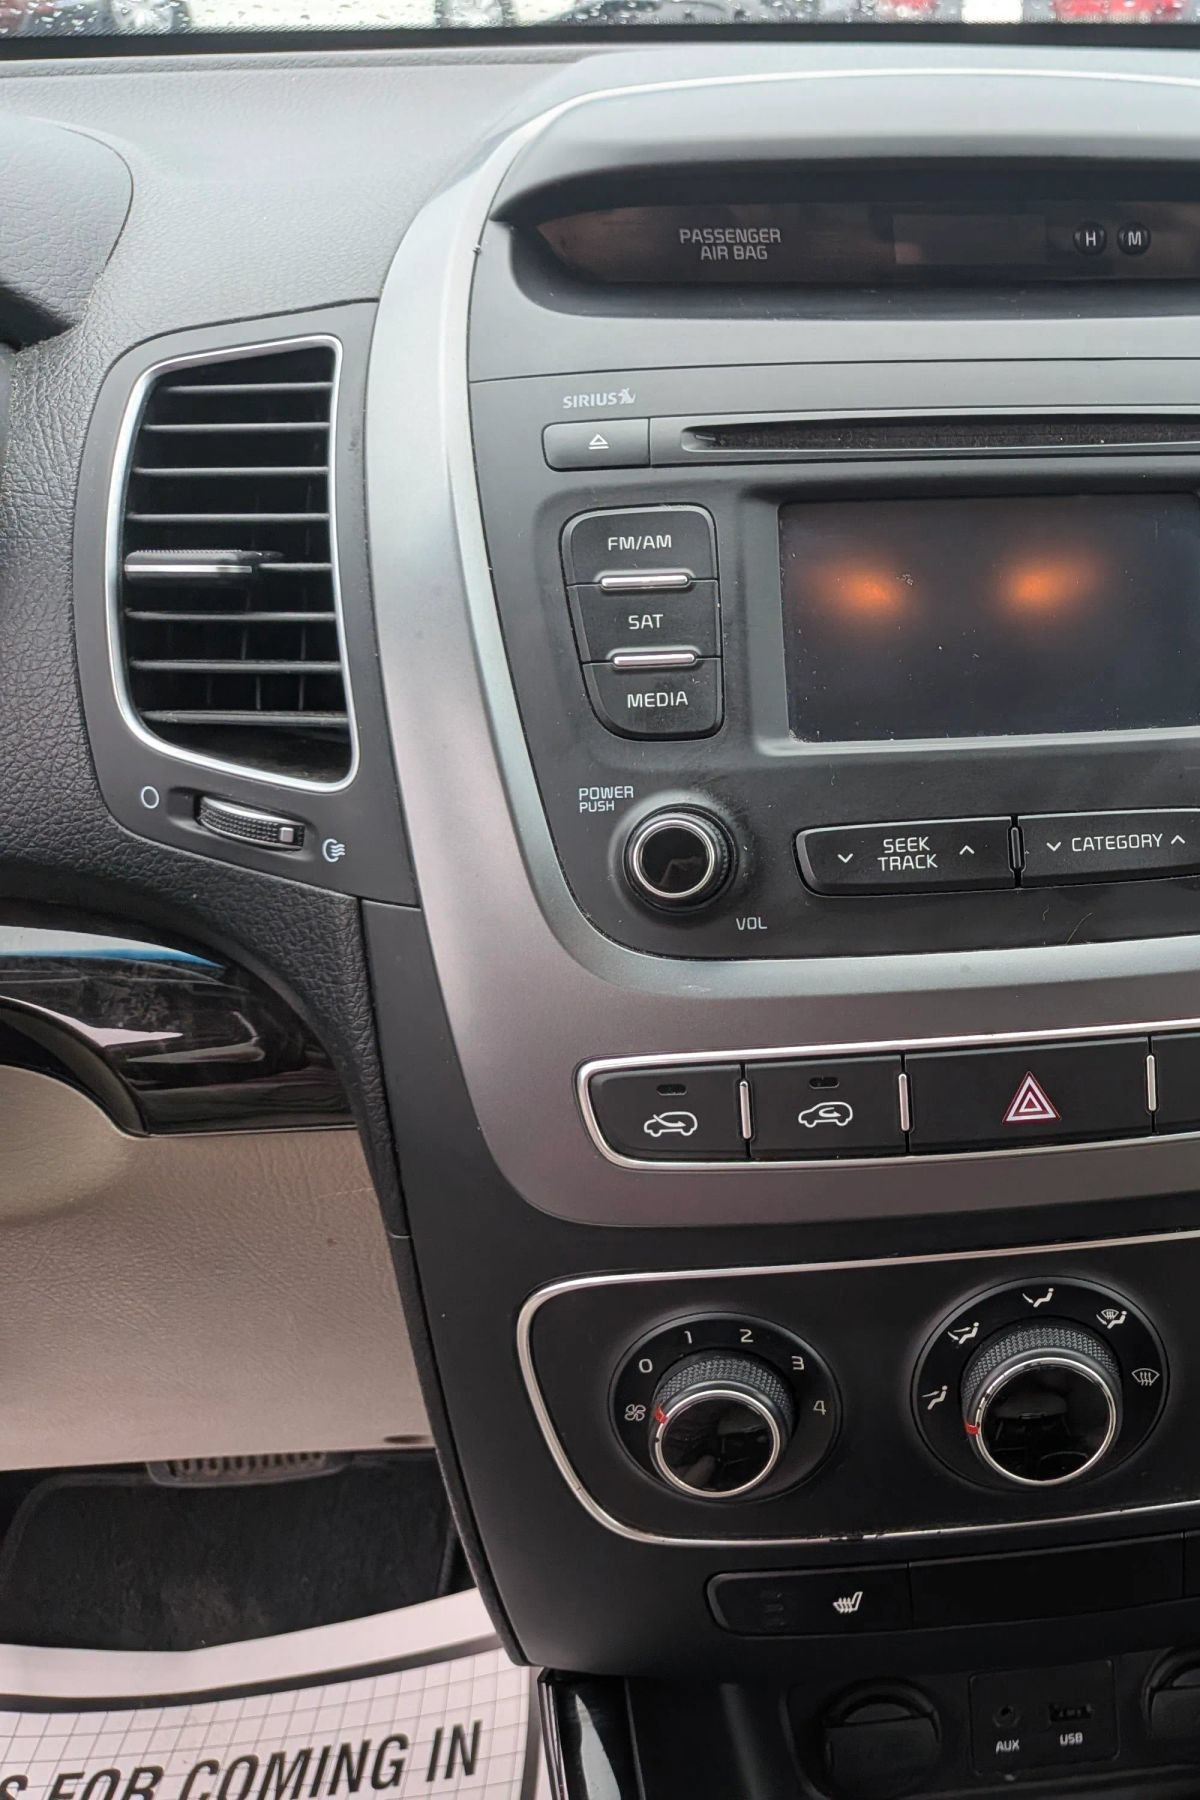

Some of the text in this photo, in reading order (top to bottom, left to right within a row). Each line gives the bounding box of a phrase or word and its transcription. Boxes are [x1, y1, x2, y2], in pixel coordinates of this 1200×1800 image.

[679, 228, 782, 244] PASSENGER
[1085, 230, 1097, 247] H
[1128, 230, 1142, 247] M
[700, 245, 768, 260] AIR BAG
[562, 392, 617, 409] SIRIUS
[607, 534, 673, 552] FM/AM
[628, 613, 664, 631] SAT
[626, 690, 689, 709] MEDIA
[578, 785, 635, 801] POWER
[579, 801, 615, 814] PUSH
[882, 836, 931, 854] SEEK
[1071, 833, 1163, 853] CATEGORY
[877, 853, 938, 872] TRACK
[735, 916, 768, 931] VOL
[683, 1330, 693, 1344] 1
[739, 1328, 754, 1343] 2
[638, 1358, 654, 1374] 0
[791, 1355, 805, 1371] 3
[812, 1400, 827, 1416] 4
[995, 1738, 1020, 1753] AUX
[1059, 1732, 1084, 1746] USB
[179, 1732, 410, 1800] COMING
[425, 1719, 484, 1782] IN
